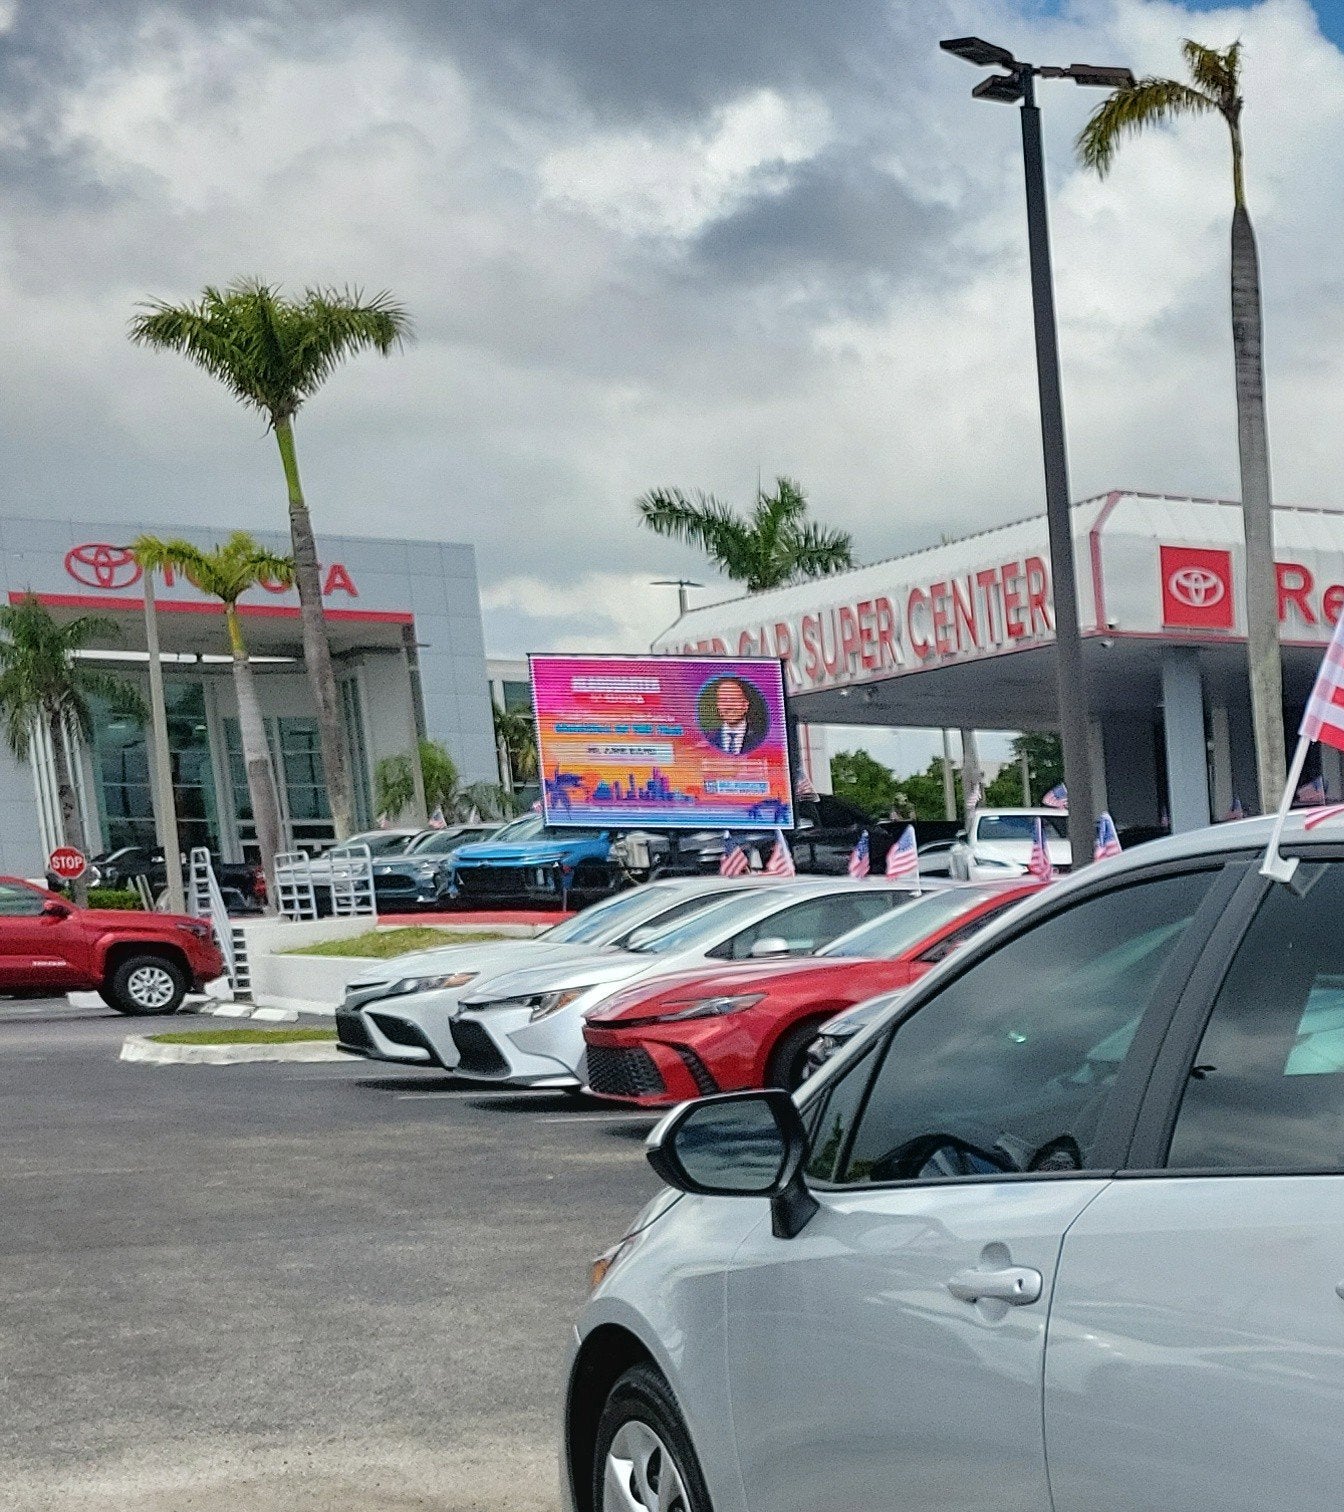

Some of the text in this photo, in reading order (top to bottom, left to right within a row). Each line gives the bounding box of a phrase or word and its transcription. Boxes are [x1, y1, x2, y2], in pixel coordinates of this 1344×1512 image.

[802, 597, 898, 680] SUPER
[907, 556, 1055, 659] CENTER
[51, 856, 83, 870] STOP
